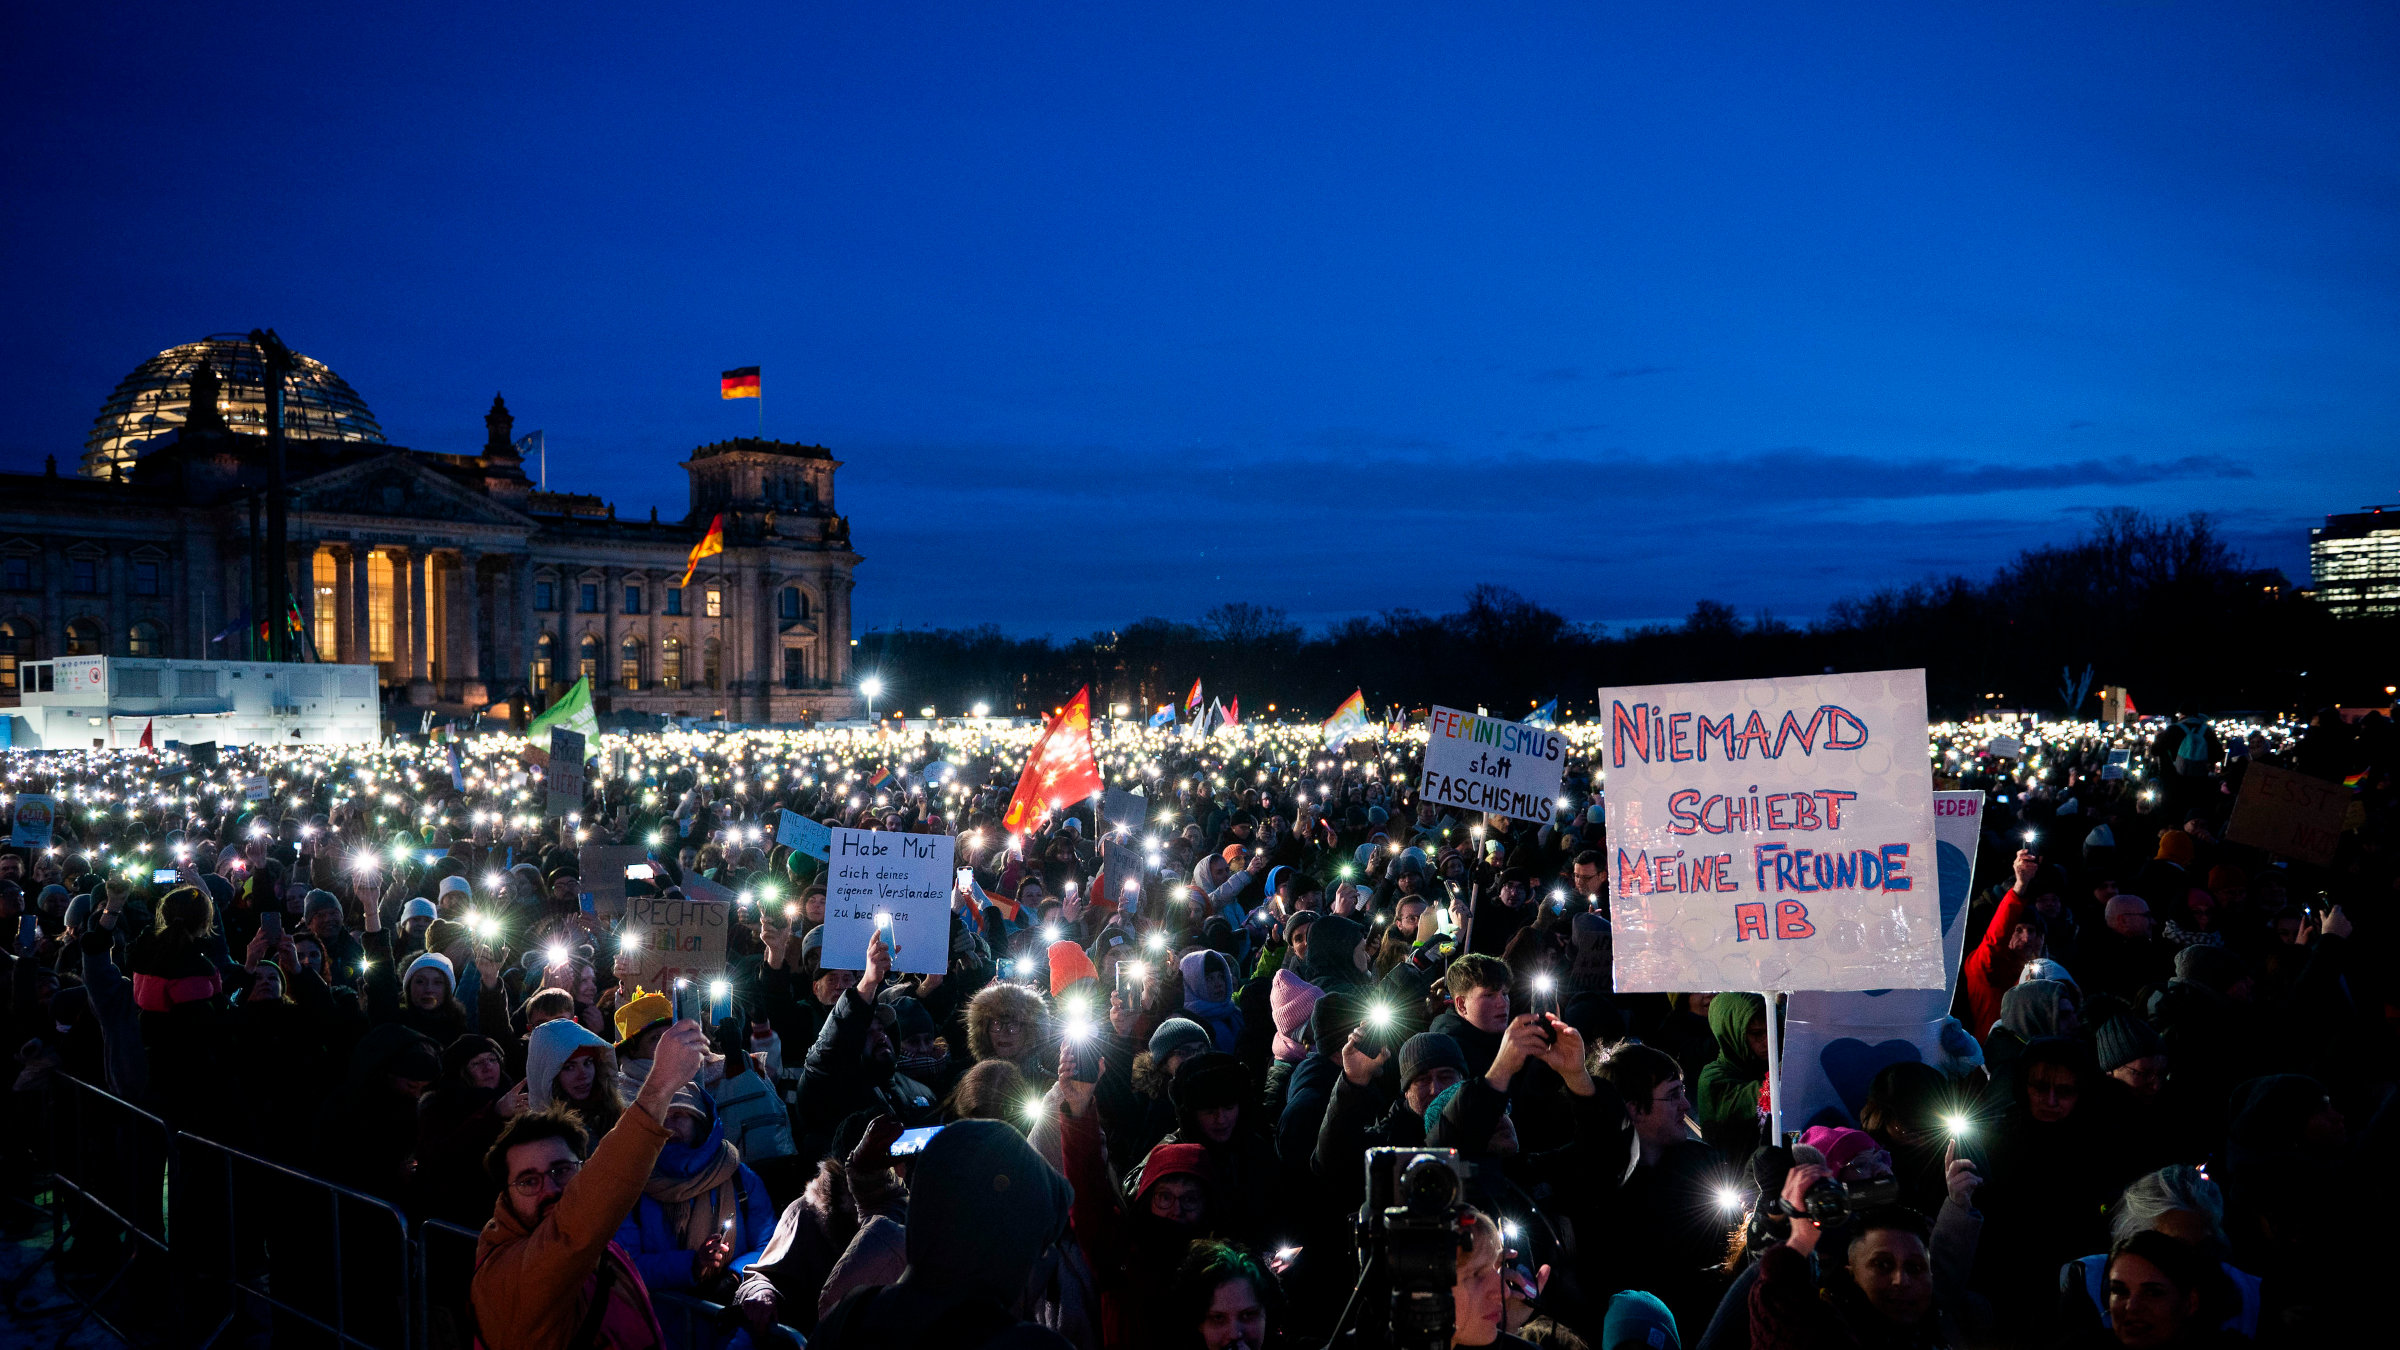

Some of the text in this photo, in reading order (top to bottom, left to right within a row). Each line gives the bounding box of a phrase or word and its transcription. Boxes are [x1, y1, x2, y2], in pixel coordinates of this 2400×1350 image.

[1432, 711, 1560, 761] FEMINISMUS
[1469, 752, 1512, 779] statt
[551, 773, 580, 796] LIEBE
[1424, 771, 1553, 822] FASCHISMUS
[2260, 774, 2338, 811] ESST
[1933, 799, 1978, 817] IEDEN
[841, 832, 889, 857] Habe
[839, 864, 909, 880] dich deines
[1754, 841, 1913, 895] FREUNDE
[837, 882, 944, 902] eigenen Verstandes
[632, 898, 725, 927] RECHTS
[833, 908, 849, 918] zu
[1734, 899, 1816, 942] AB
